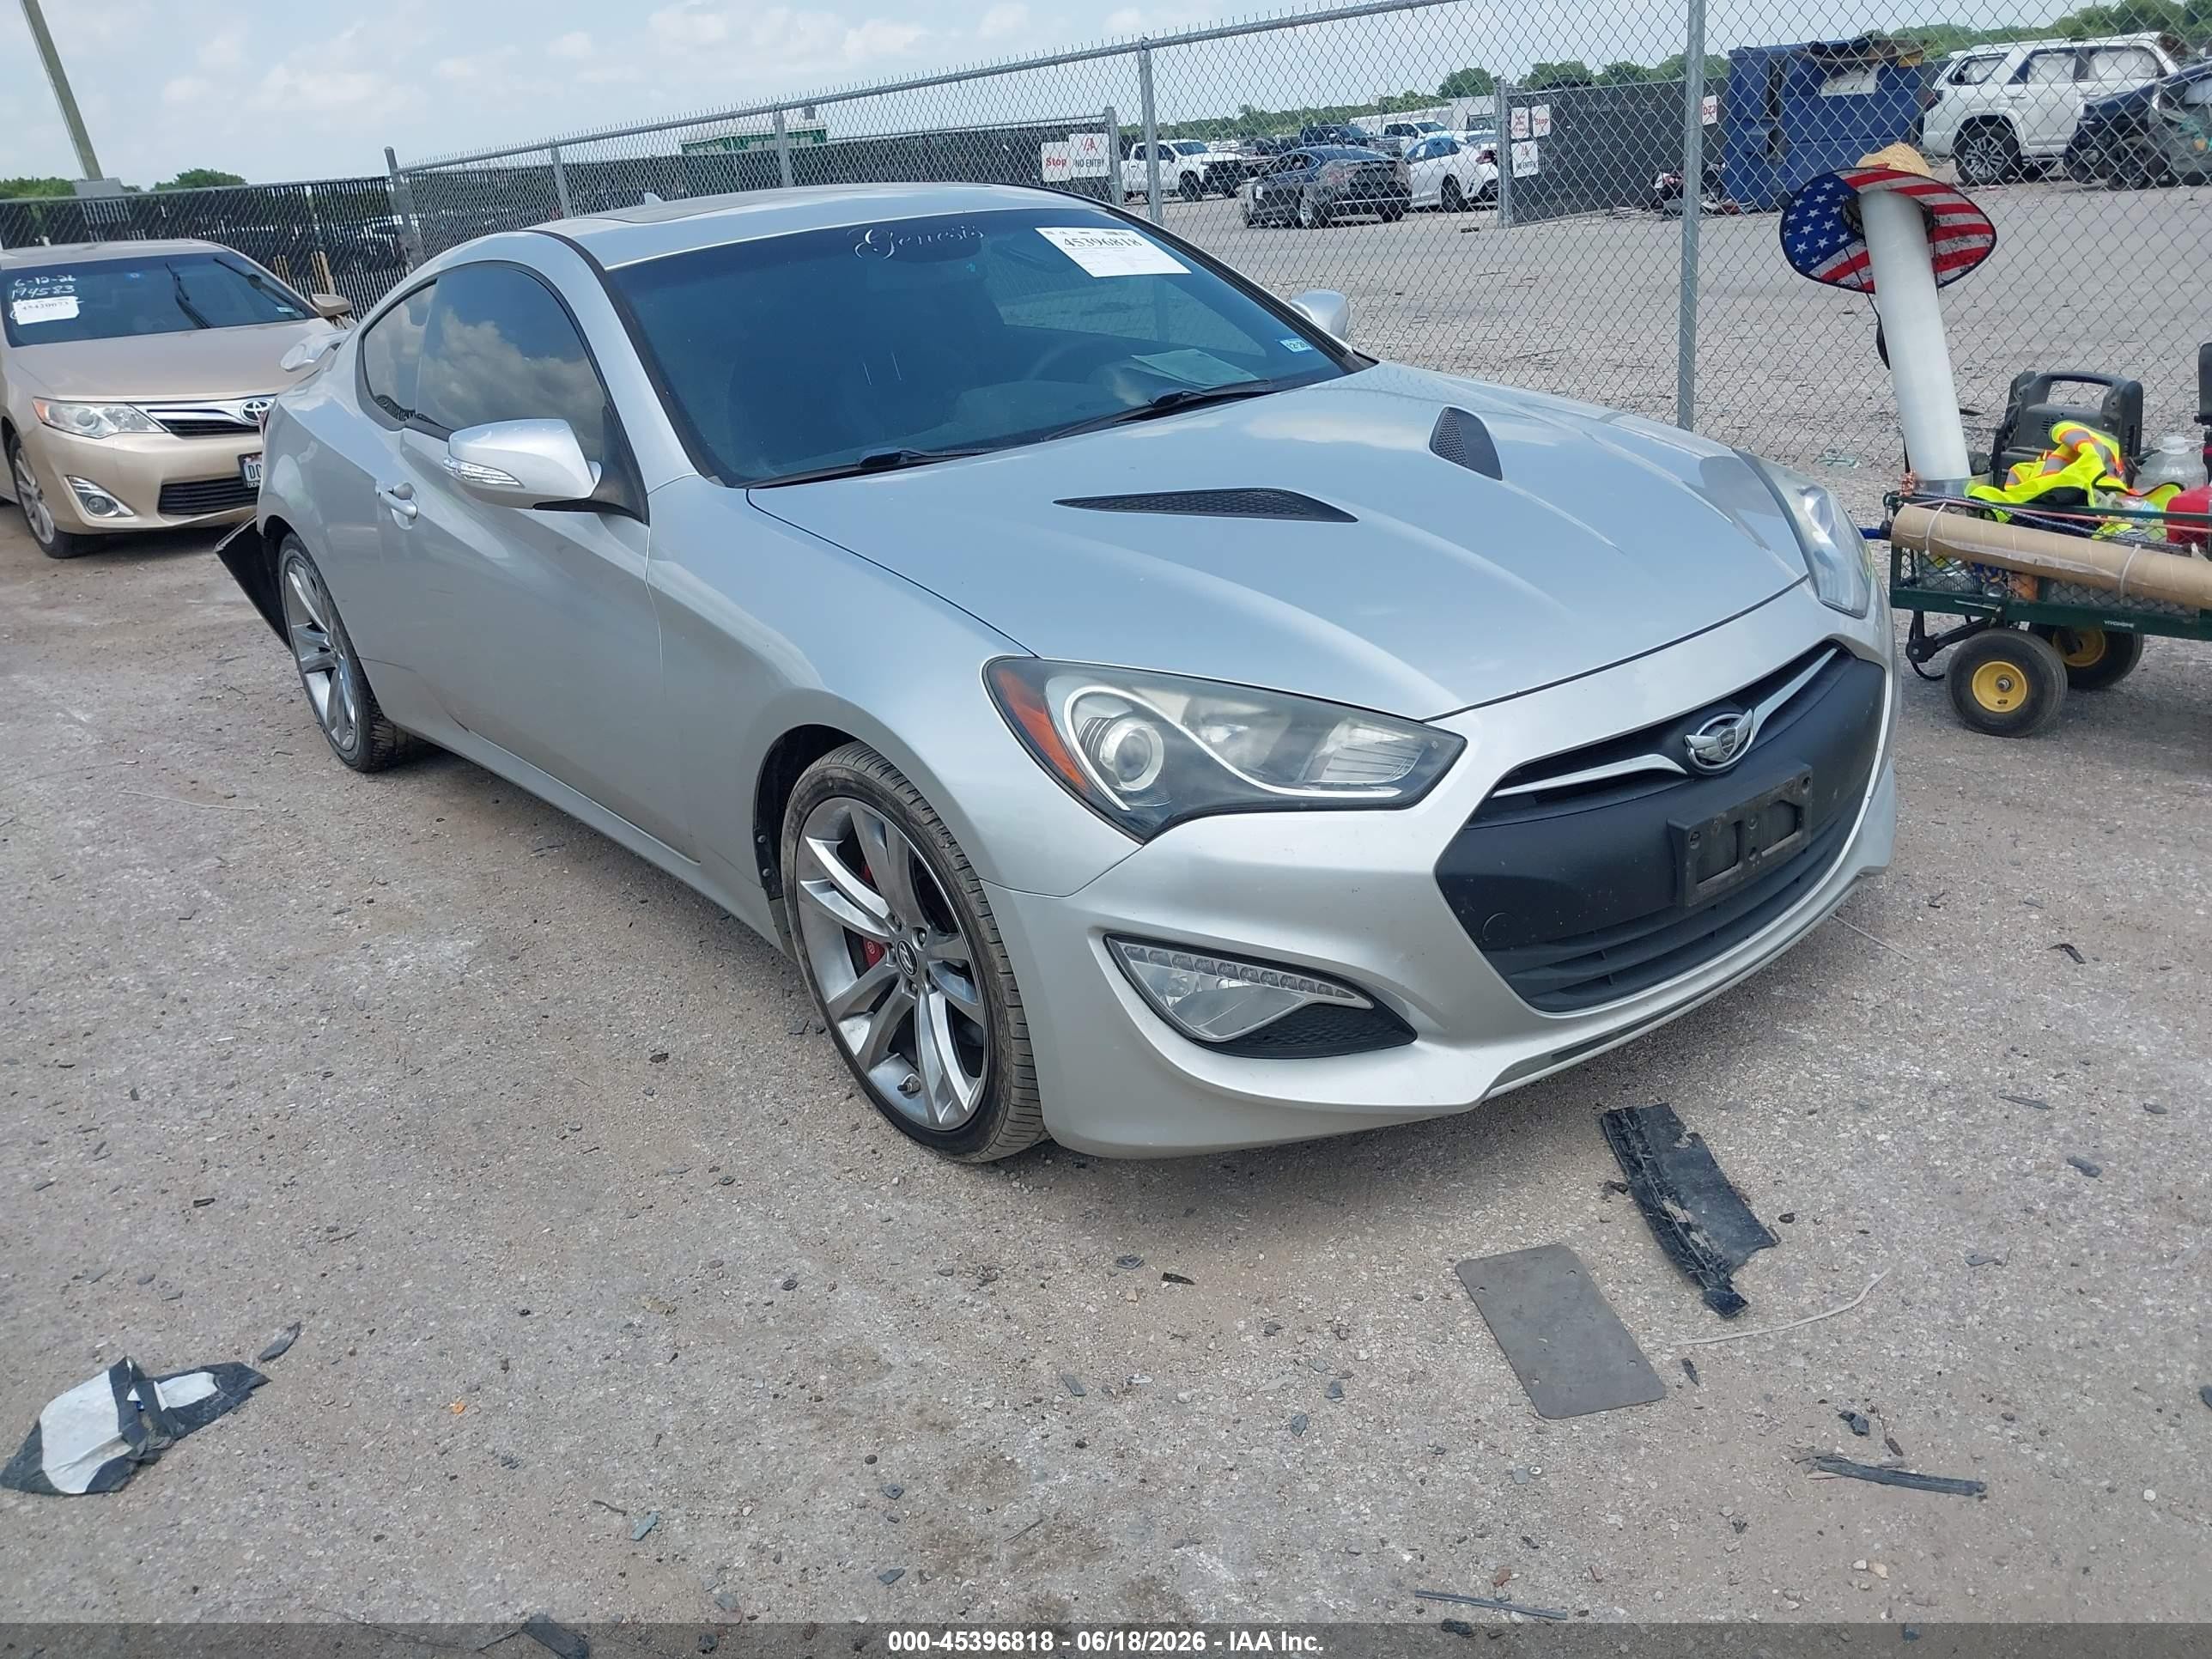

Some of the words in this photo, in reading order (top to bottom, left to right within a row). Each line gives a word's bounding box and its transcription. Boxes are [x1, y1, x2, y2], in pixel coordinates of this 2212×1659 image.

[1046, 157, 1066, 167] Stop
[1075, 159, 1085, 167] NO
[1085, 159, 1105, 167] ENTRY
[847, 225, 985, 259] Genesis
[1064, 238, 1142, 247] 45396818
